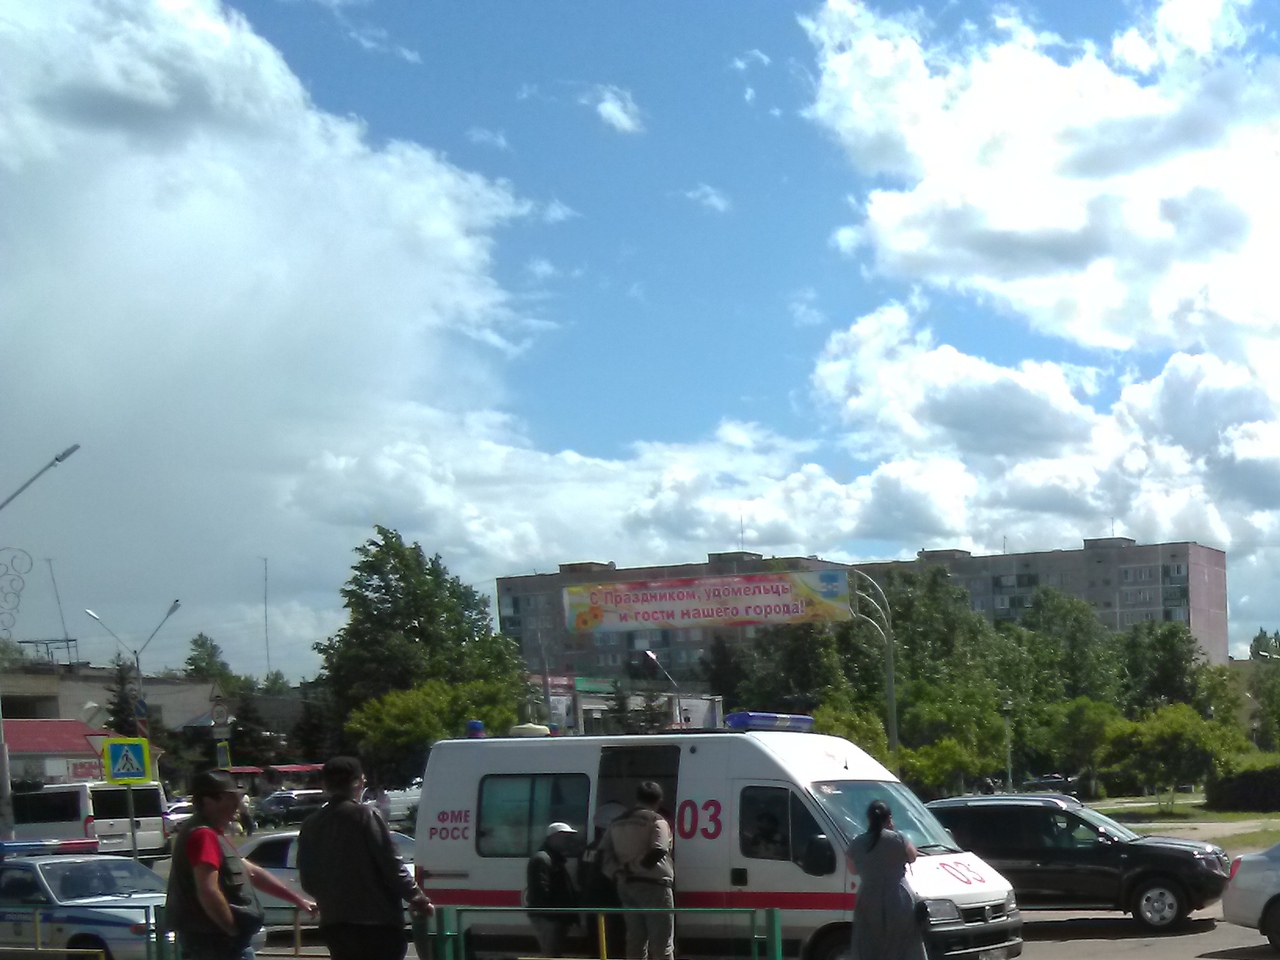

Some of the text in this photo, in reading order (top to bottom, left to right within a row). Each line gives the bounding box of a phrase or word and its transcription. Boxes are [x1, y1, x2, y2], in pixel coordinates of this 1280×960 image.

[590, 584, 792, 607] С Праздником, удомельцы
[619, 600, 805, 623] и гости нашего города!
[677, 799, 723, 840] 03
[429, 826, 470, 841] РОСС
[940, 861, 985, 885] 03
